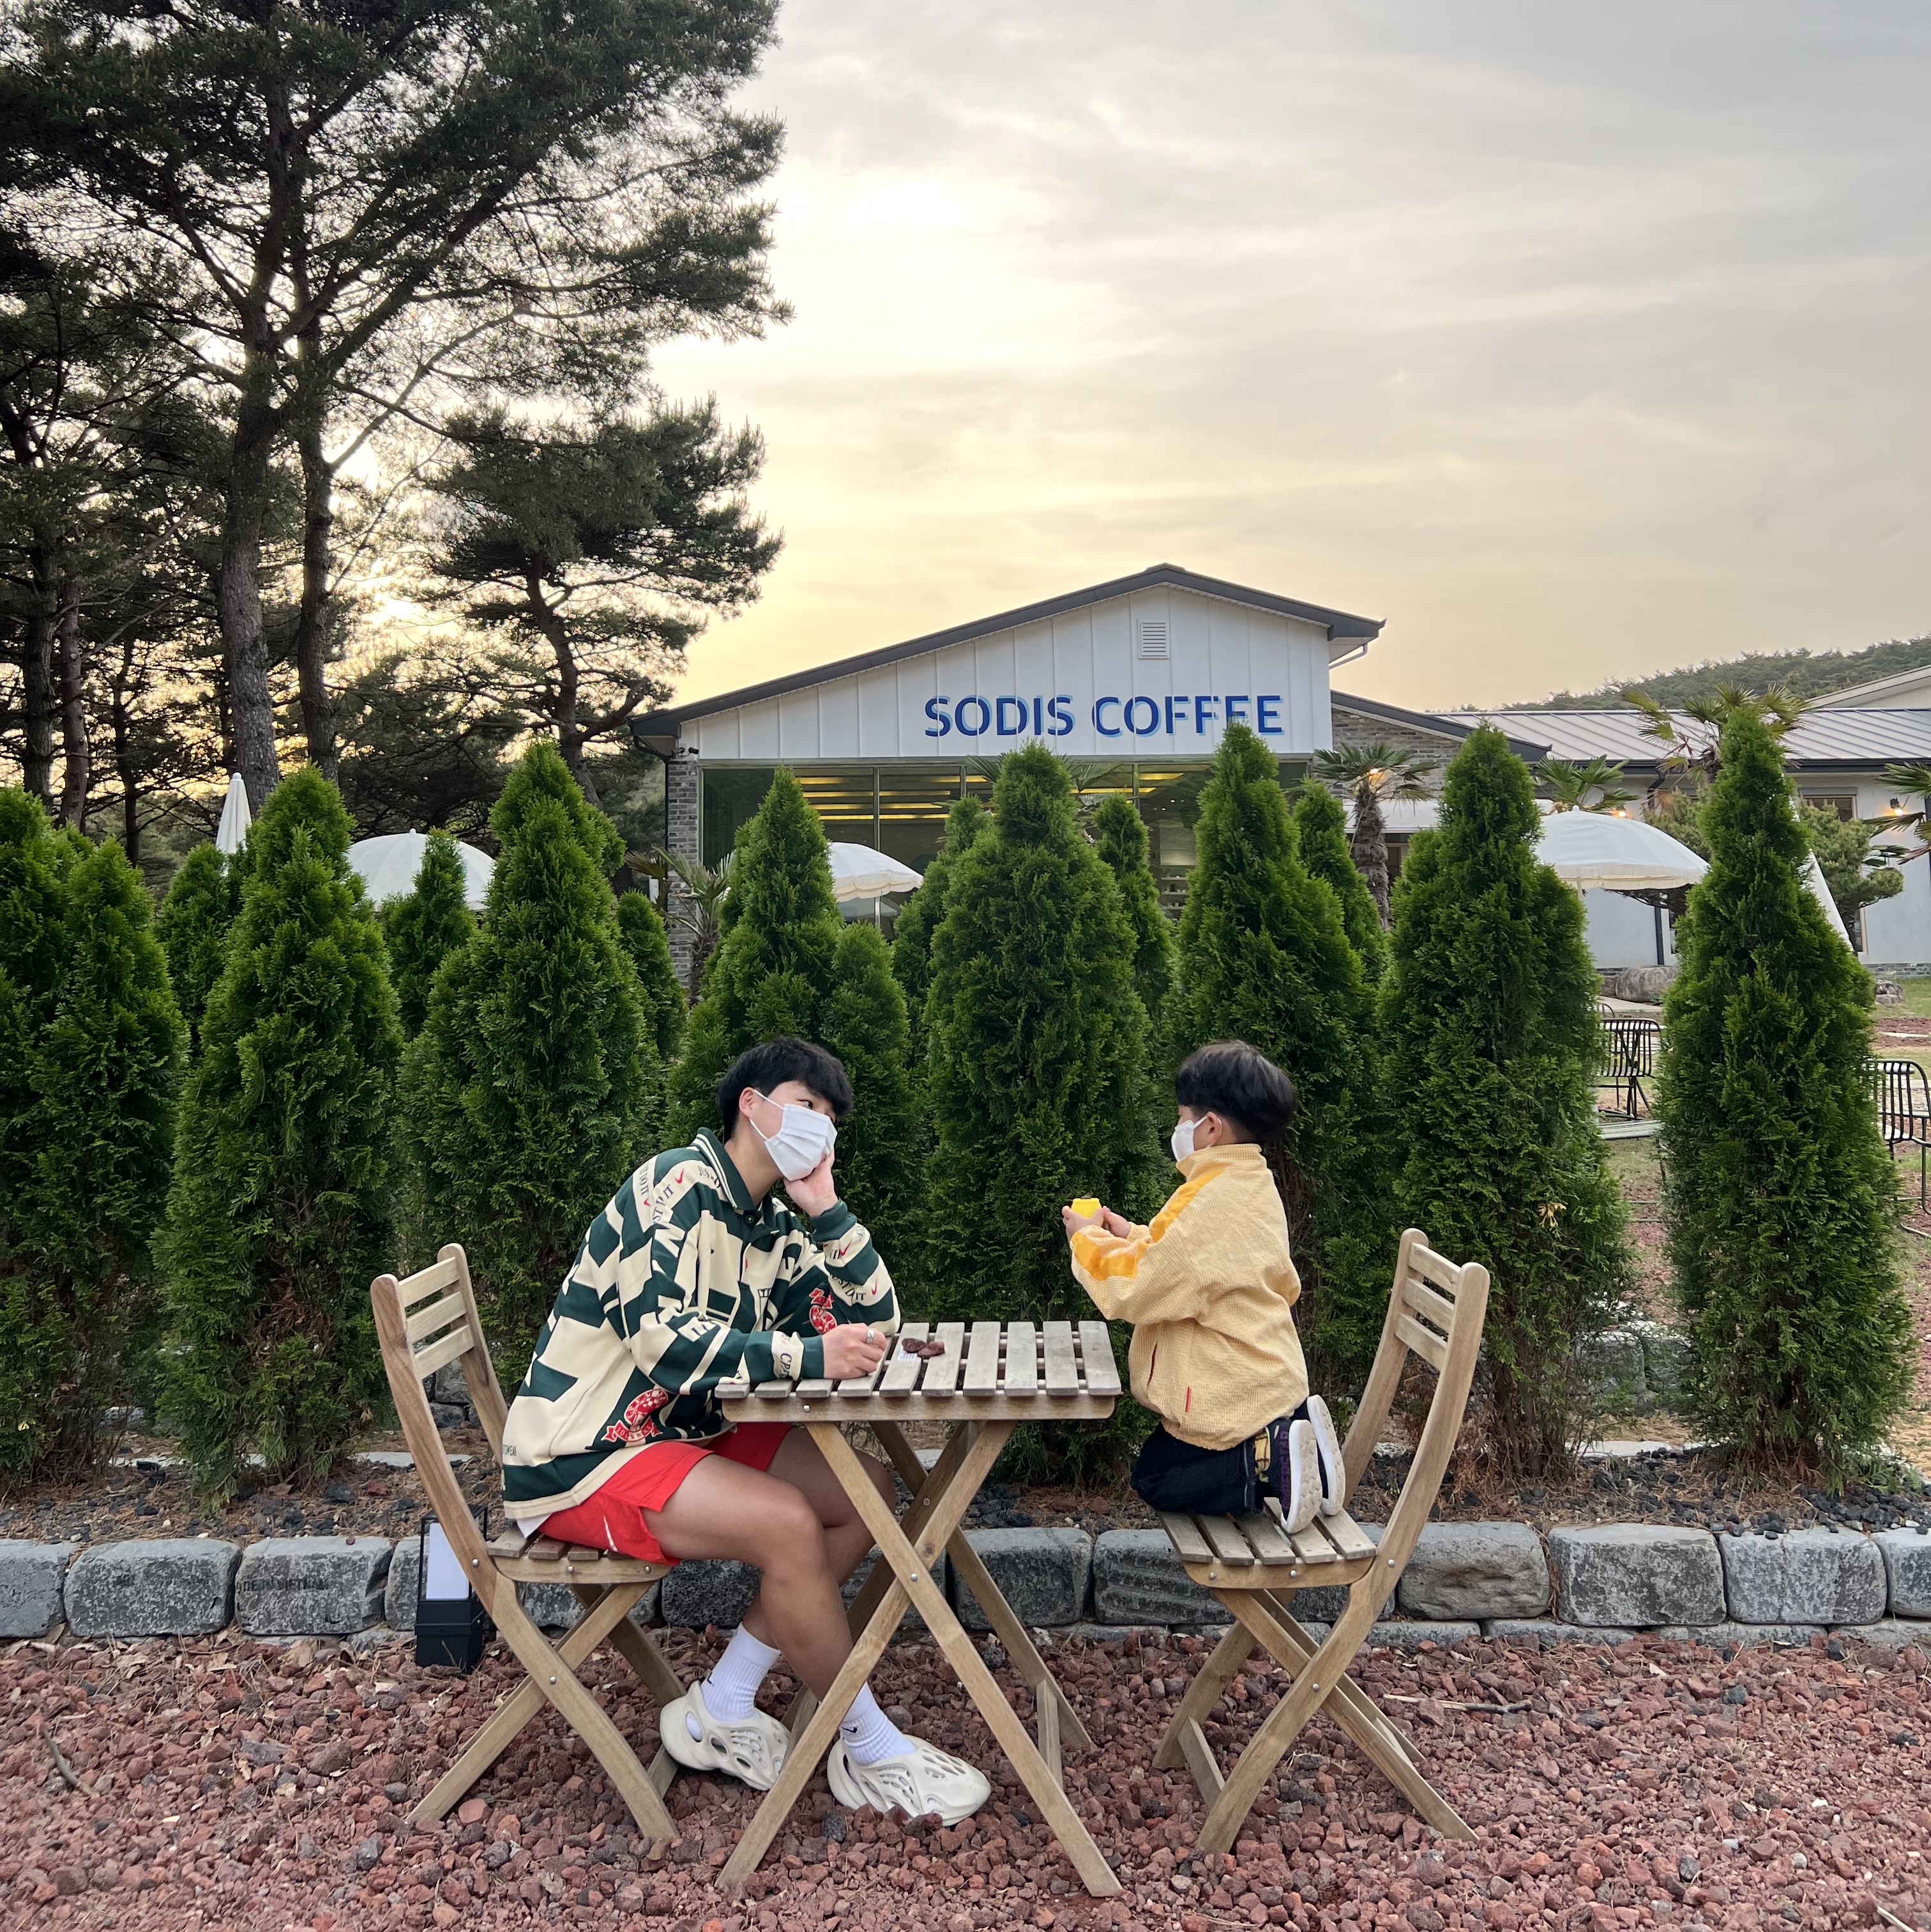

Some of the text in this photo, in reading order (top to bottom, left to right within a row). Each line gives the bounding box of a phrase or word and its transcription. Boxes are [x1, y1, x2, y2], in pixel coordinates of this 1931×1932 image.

[925, 694, 1285, 737] SODIS COFFEE
[663, 1183, 674, 1199] IT
[855, 1291, 866, 1300] IT
